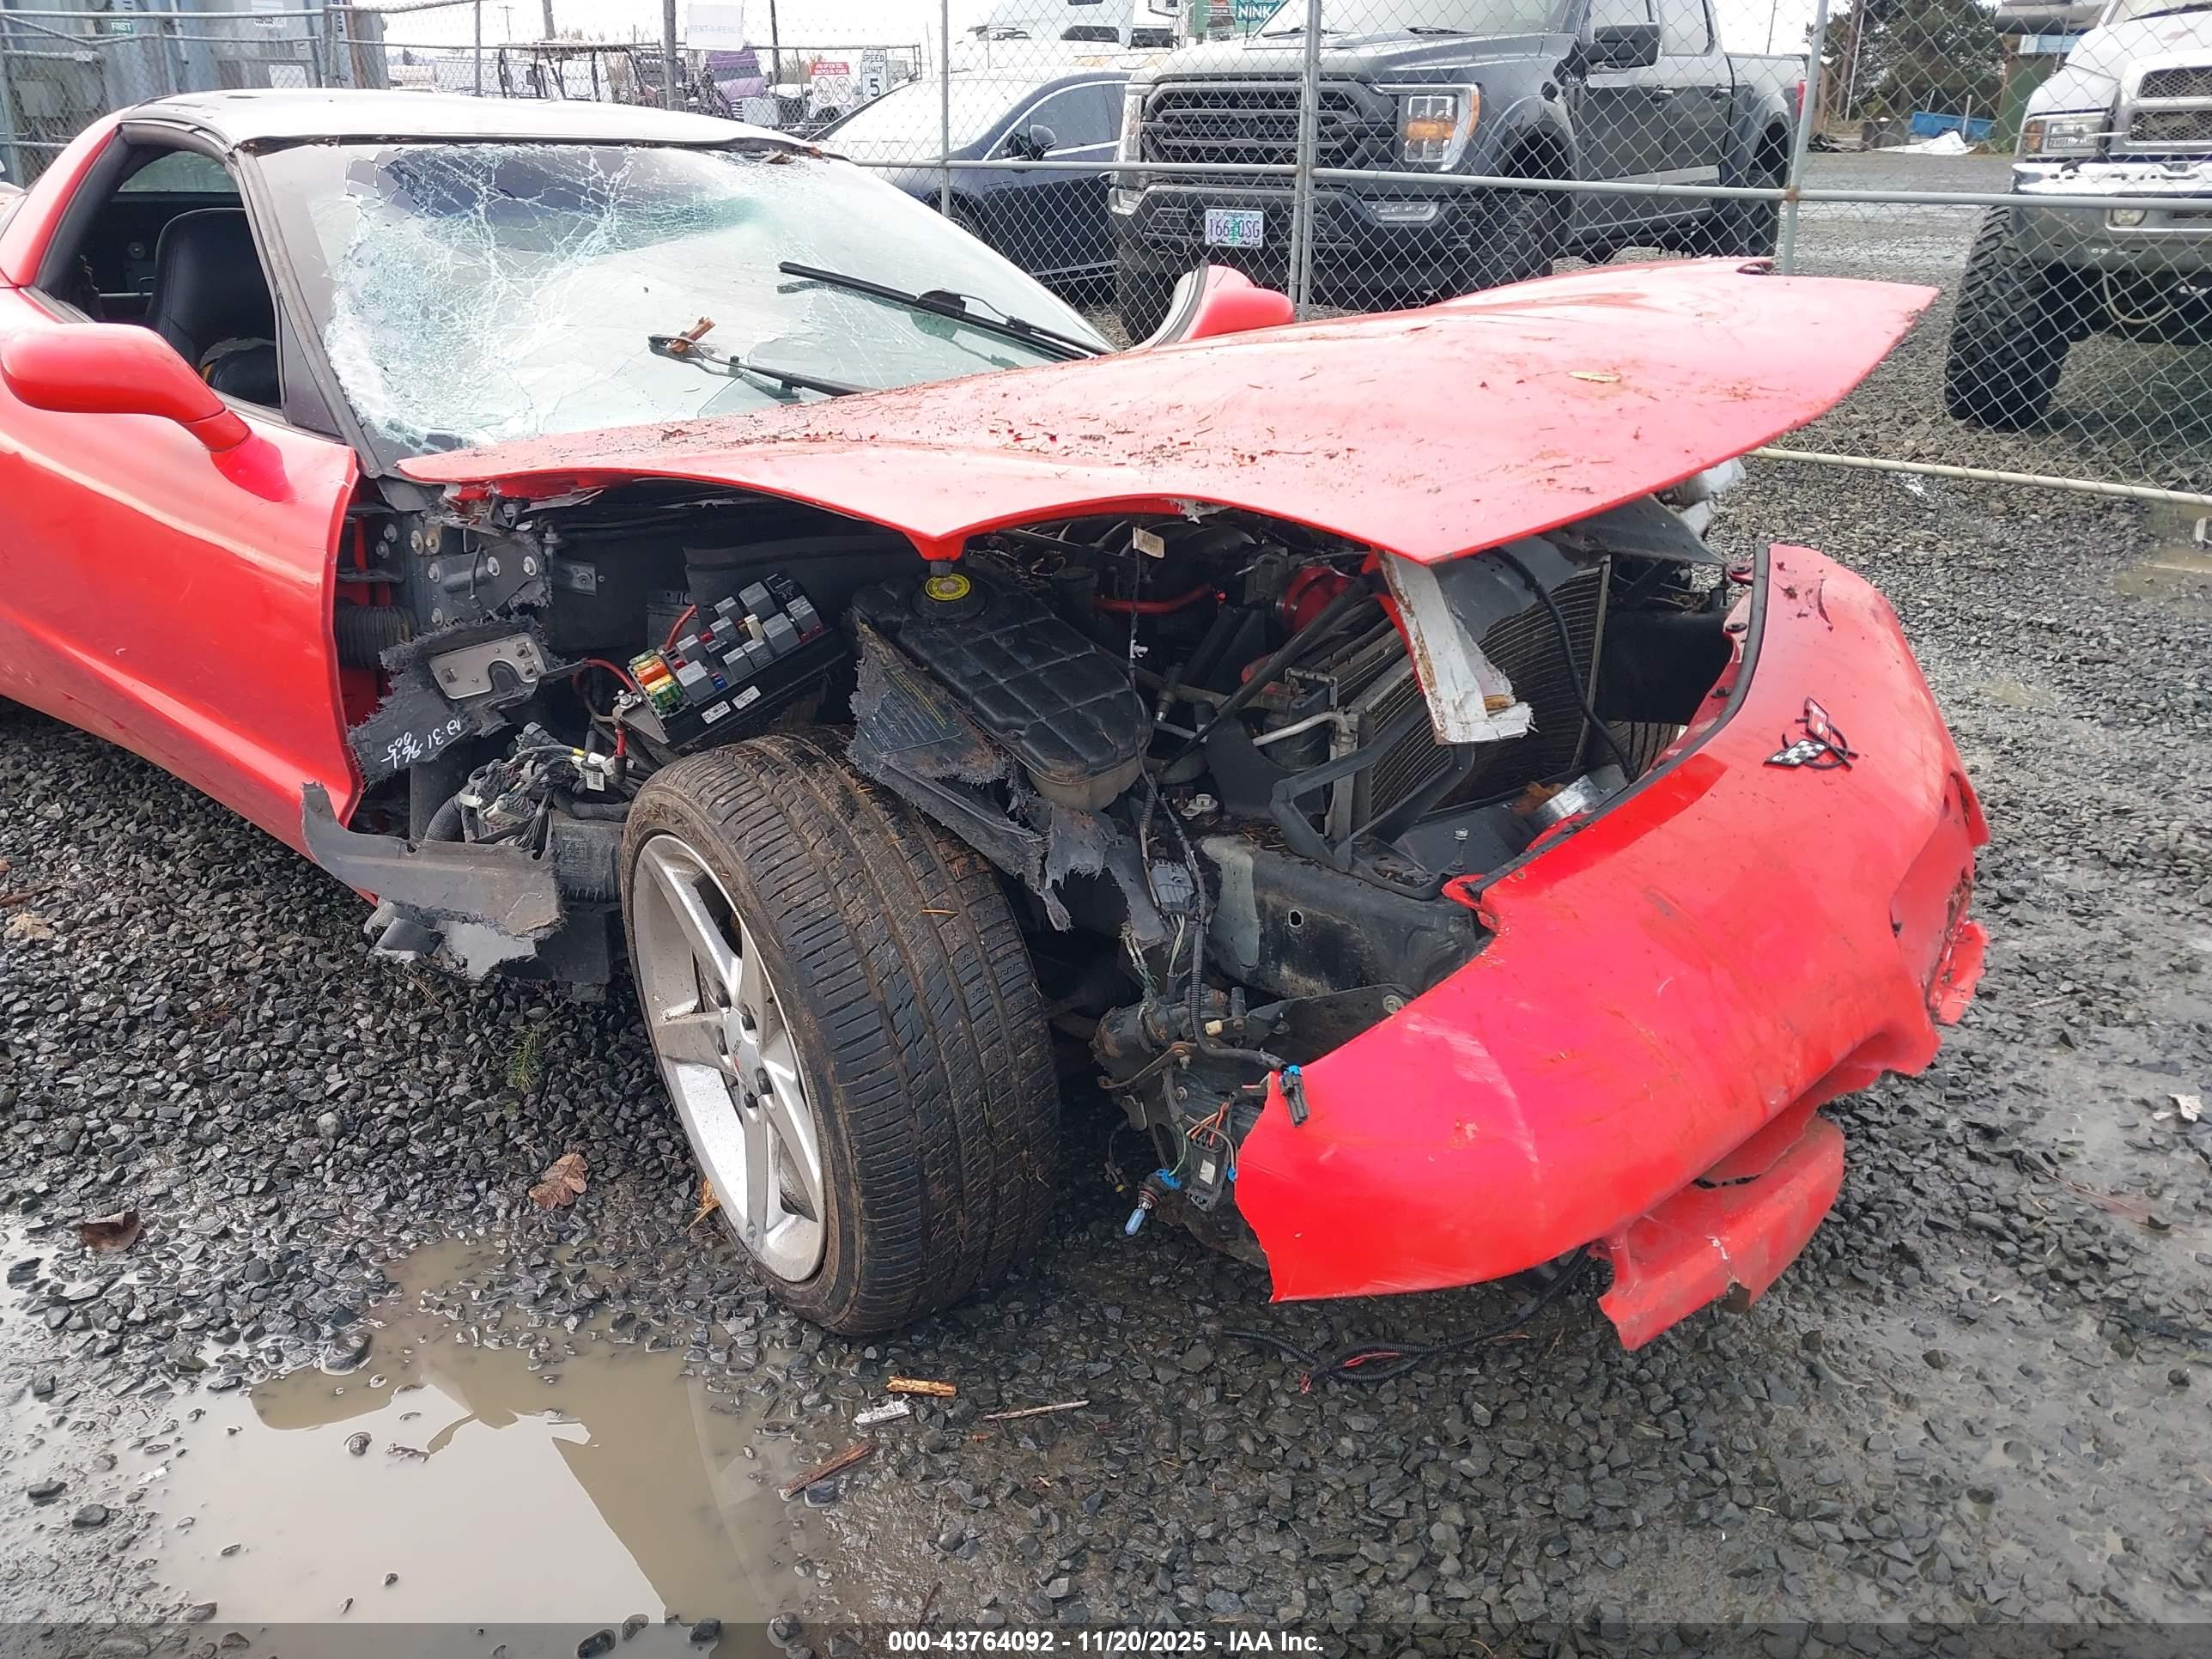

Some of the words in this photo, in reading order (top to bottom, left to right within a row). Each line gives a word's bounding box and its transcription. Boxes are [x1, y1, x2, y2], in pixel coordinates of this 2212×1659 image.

[862, 54, 884, 63] SPEED
[863, 65, 884, 75] LIMIT
[869, 77, 880, 97] 5
[1209, 218, 1230, 237] 166
